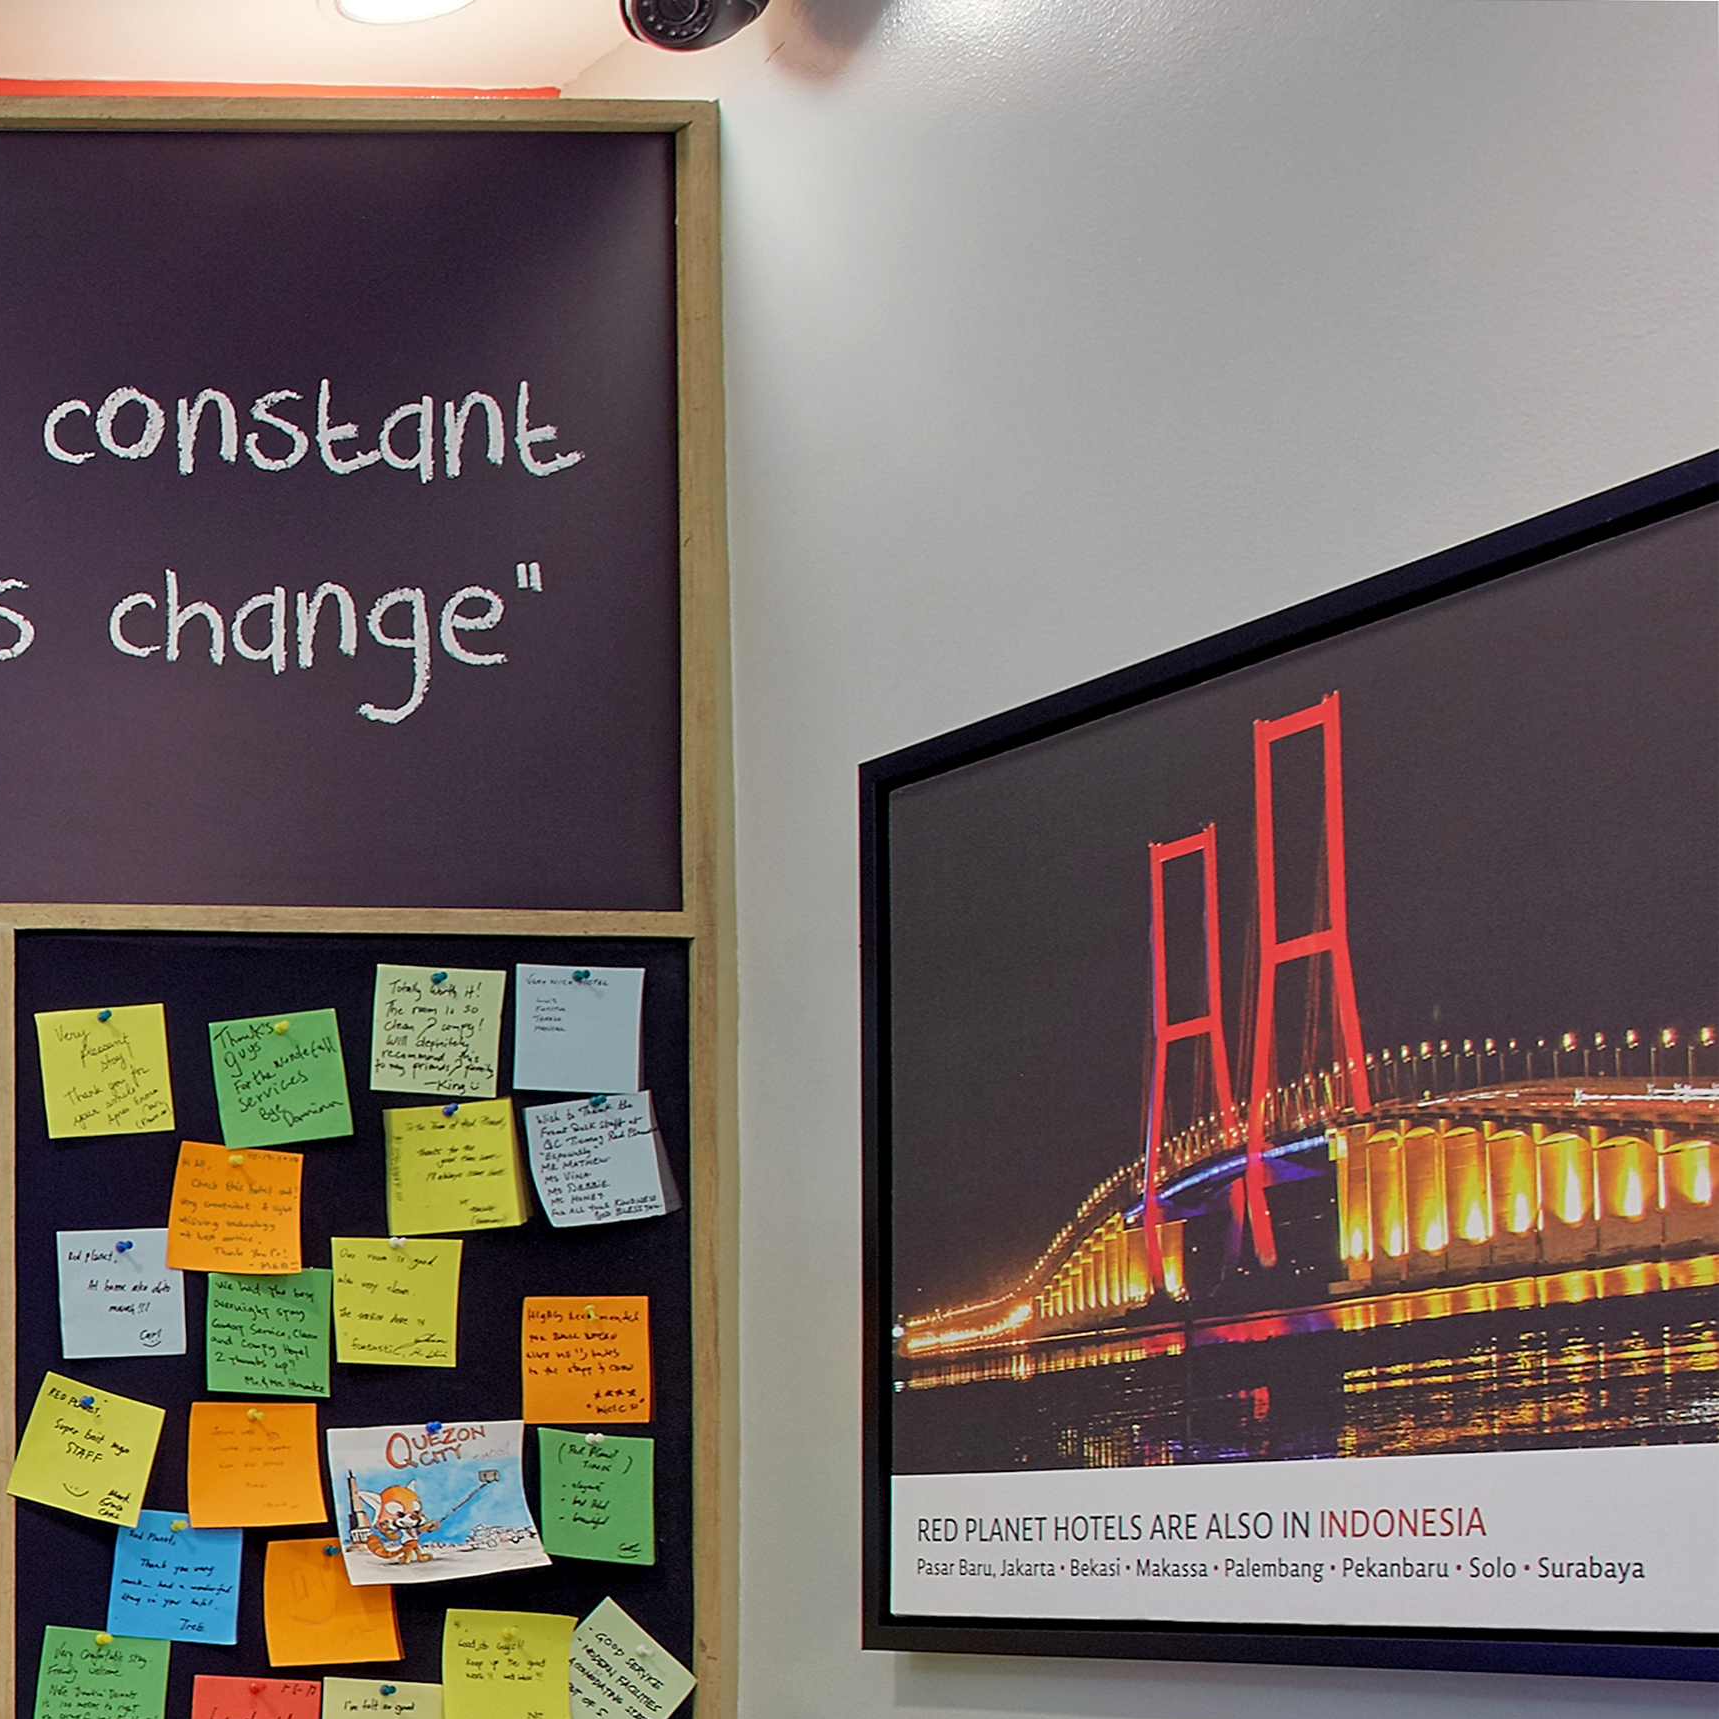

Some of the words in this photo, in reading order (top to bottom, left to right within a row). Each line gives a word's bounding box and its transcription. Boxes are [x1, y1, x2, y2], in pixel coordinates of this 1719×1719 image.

[43, 377, 586, 484] constant
[108, 559, 544, 725] change"
[418, 1444, 462, 1466] CITY
[916, 1517, 959, 1543] RED
[964, 1515, 1047, 1543] PLANET
[1054, 1514, 1143, 1541] HOTELS
[1150, 1512, 1198, 1541] ARE
[1205, 1512, 1274, 1540] ALSO
[1282, 1511, 1311, 1539] IN
[1319, 1507, 1487, 1539] INDONESIA
[916, 1559, 954, 1577] Pasar
[959, 1559, 996, 1579] Baru,
[1000, 1559, 1056, 1579] Jakarta
[1070, 1558, 1122, 1578] Bekasi
[1135, 1558, 1208, 1578] Makassa
[1224, 1558, 1324, 1583] Palembang
[1342, 1557, 1449, 1579] Pekanbaru
[1469, 1557, 1517, 1580] Solo
[1537, 1557, 1645, 1584] Surabaya
